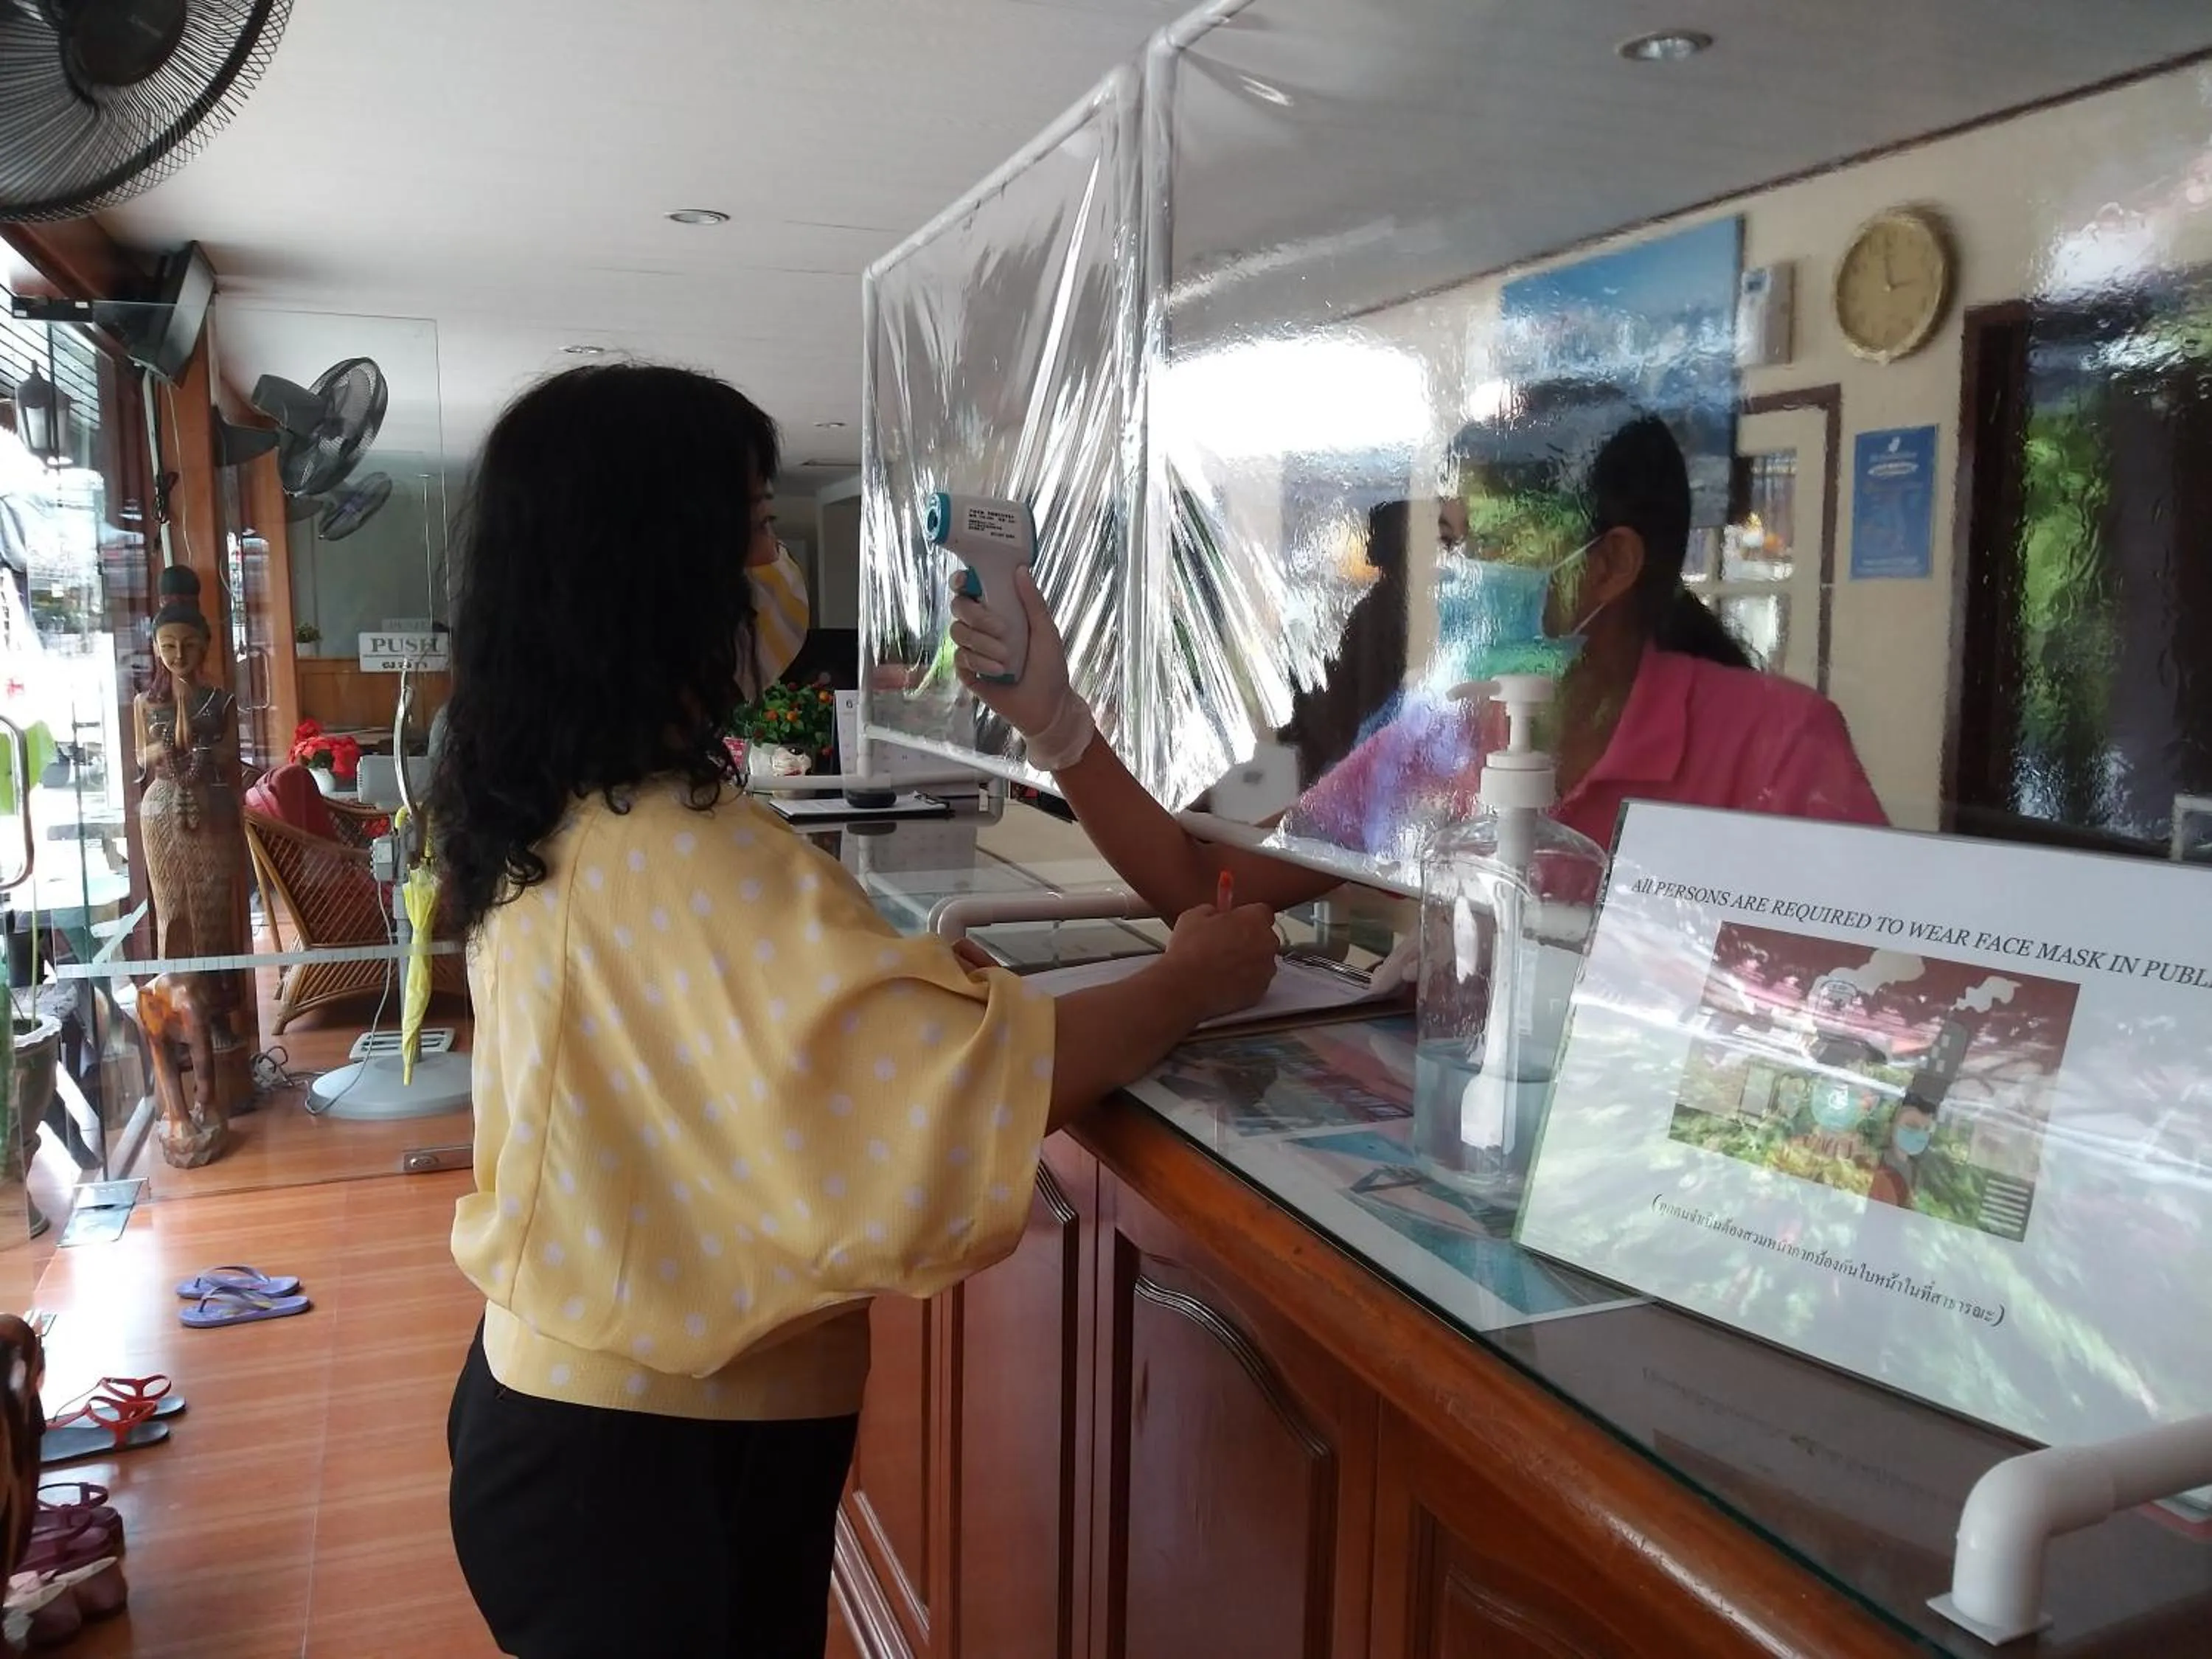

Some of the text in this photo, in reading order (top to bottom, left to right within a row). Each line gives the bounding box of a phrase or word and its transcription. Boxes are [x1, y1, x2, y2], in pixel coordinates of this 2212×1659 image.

[371, 638, 439, 653] PUSH
[1631, 878, 2212, 989] All PERSONS ARE REQUIRED TO WEAR FACE MASK IN PUBL
